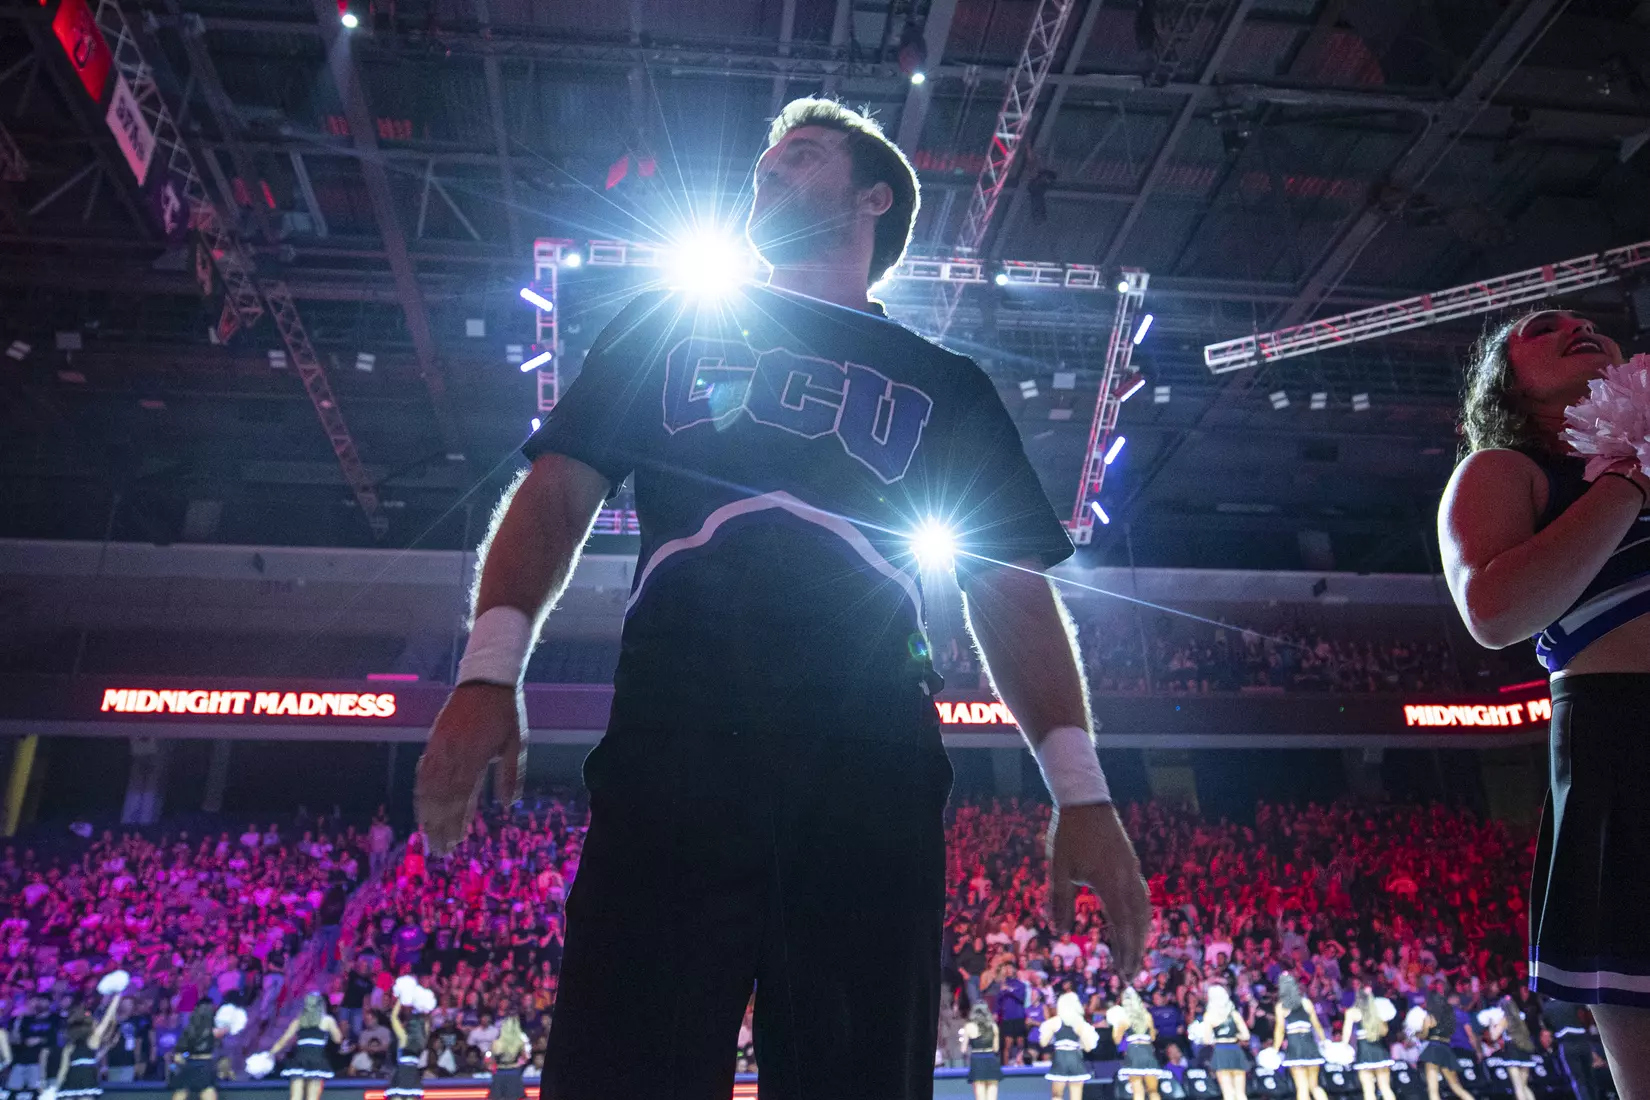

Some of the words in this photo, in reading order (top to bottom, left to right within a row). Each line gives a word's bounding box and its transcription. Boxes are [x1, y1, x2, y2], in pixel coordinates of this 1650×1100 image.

[663, 336, 933, 484] GCU
[101, 689, 251, 714] MIDNIGHT
[253, 692, 396, 718] MADNESS
[935, 702, 1018, 724] MADN
[1404, 703, 1523, 726] MIDNIGHT
